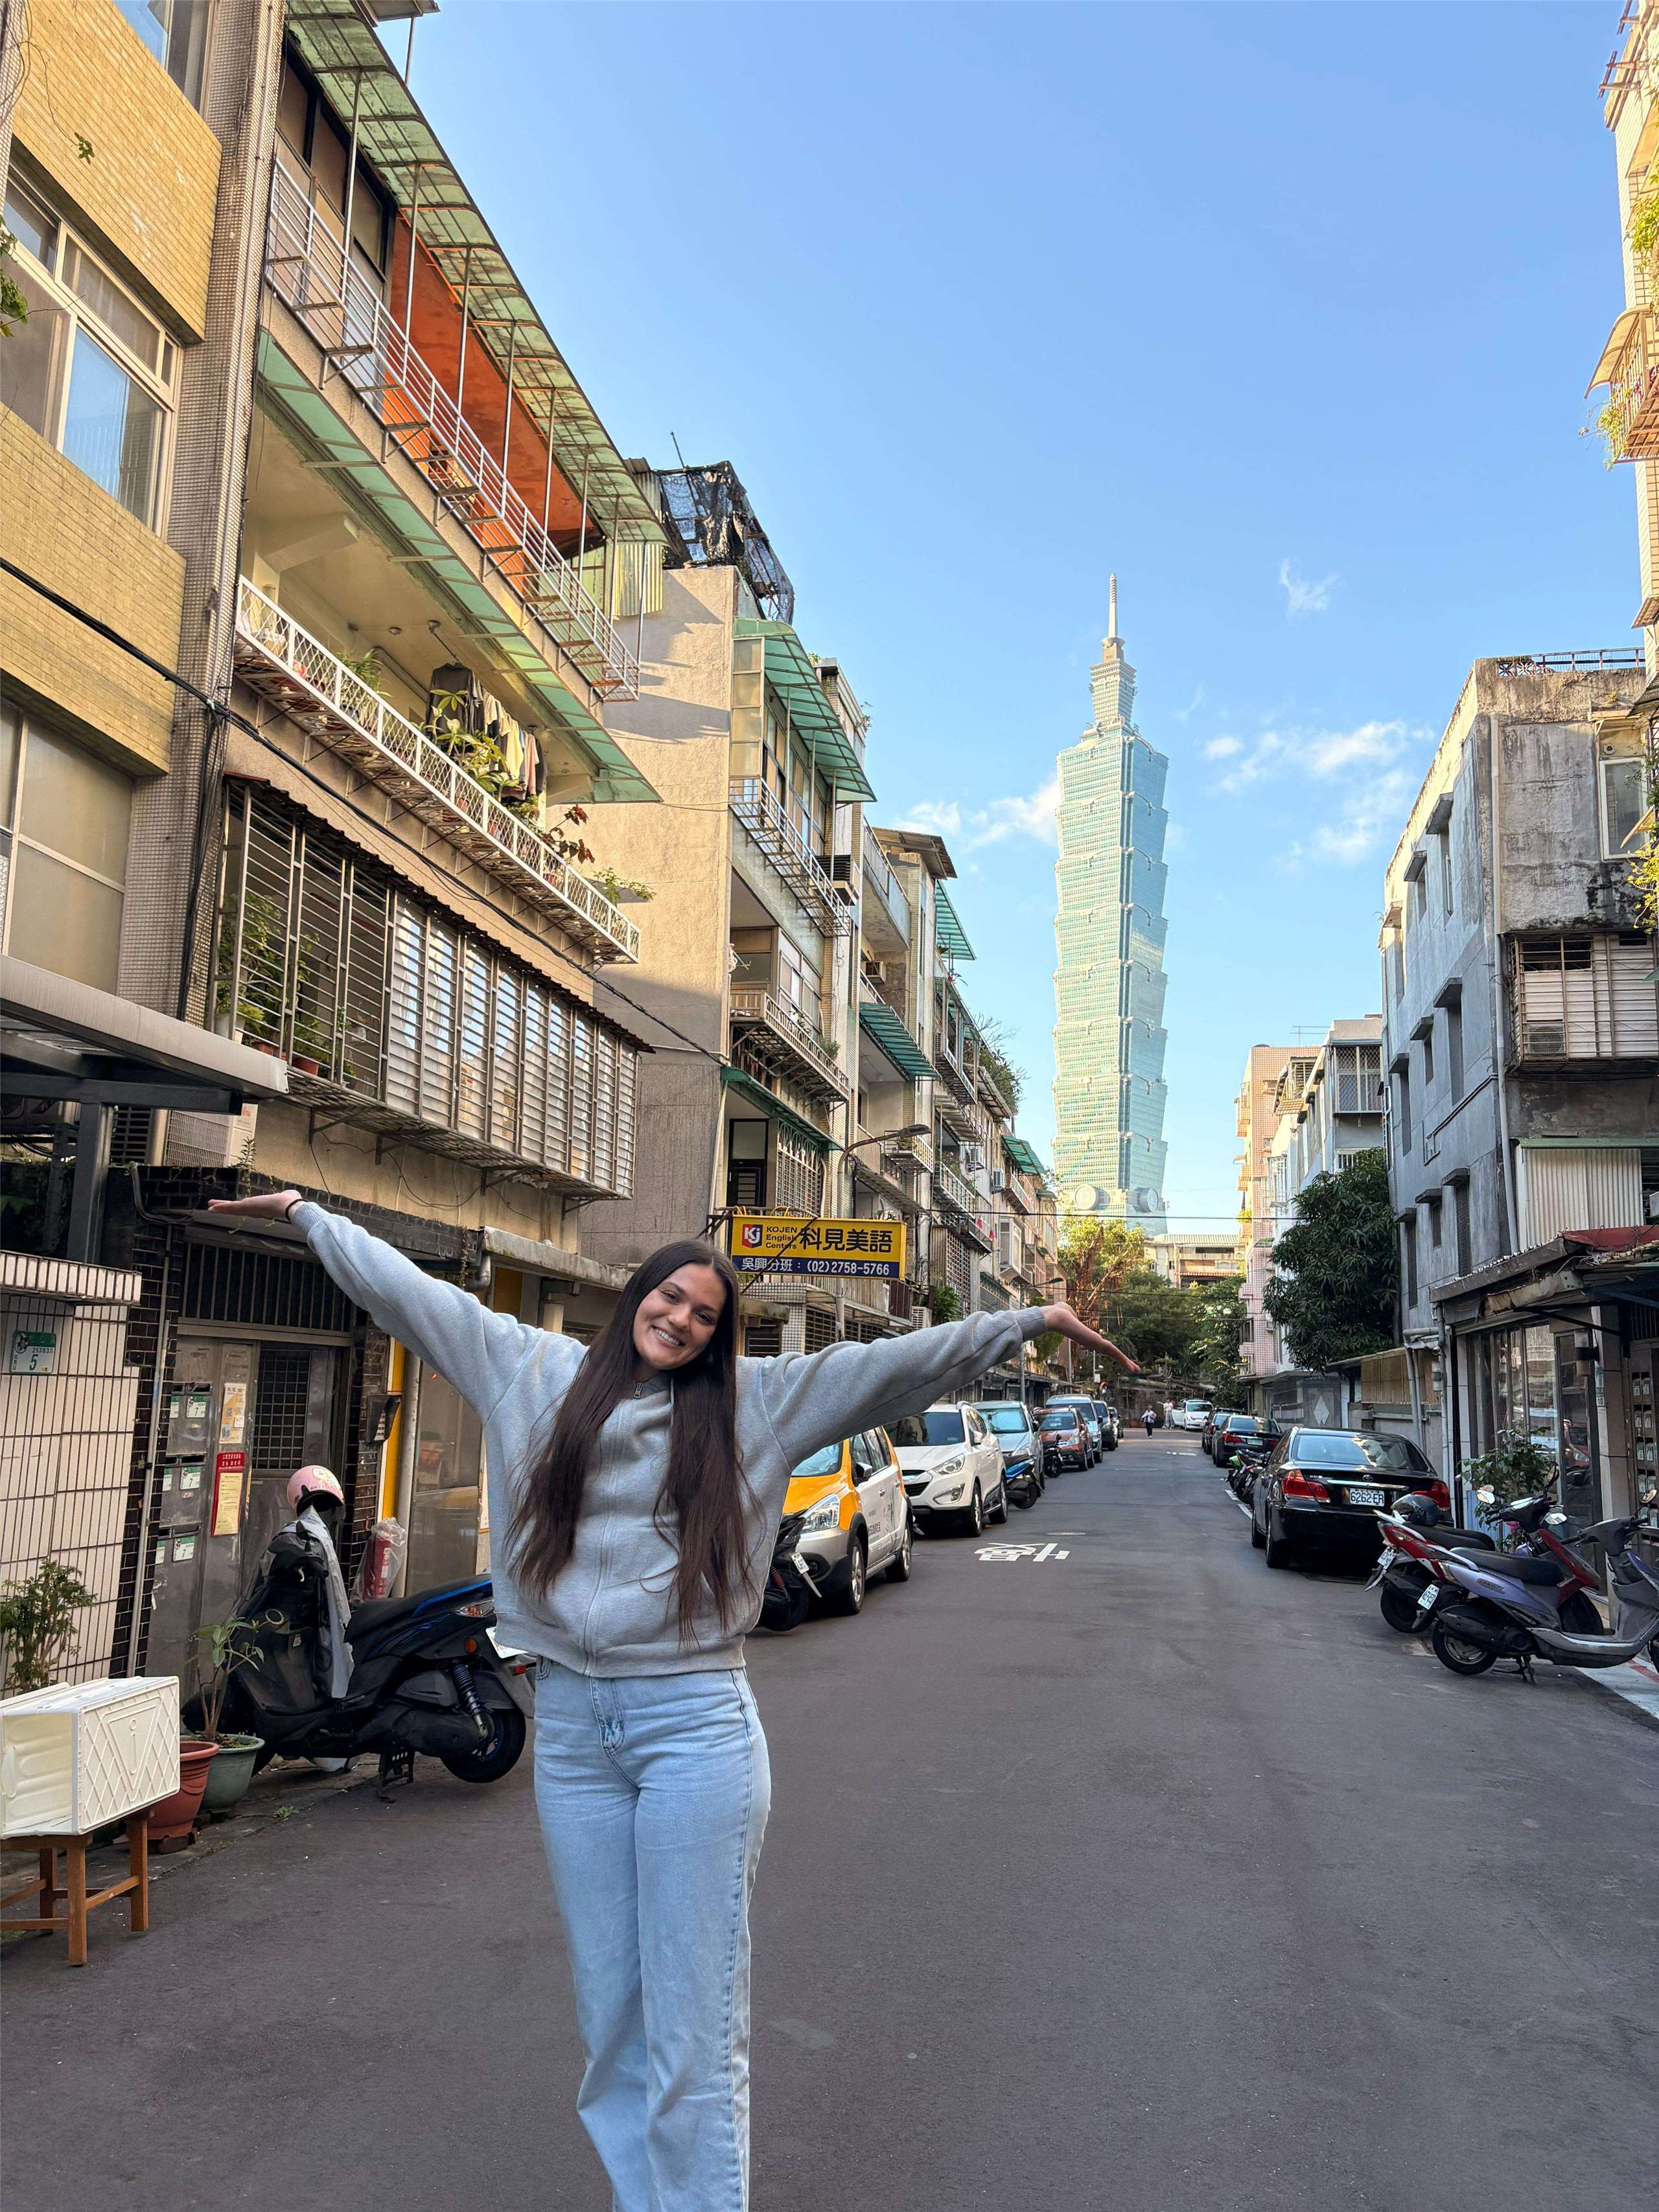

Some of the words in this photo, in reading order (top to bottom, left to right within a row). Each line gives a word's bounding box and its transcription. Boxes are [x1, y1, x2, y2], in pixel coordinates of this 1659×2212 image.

[799, 1227, 892, 1253] 科見美語
[807, 1261, 890, 1275] (02)2758-5766
[29, 1354, 38, 1370] 5
